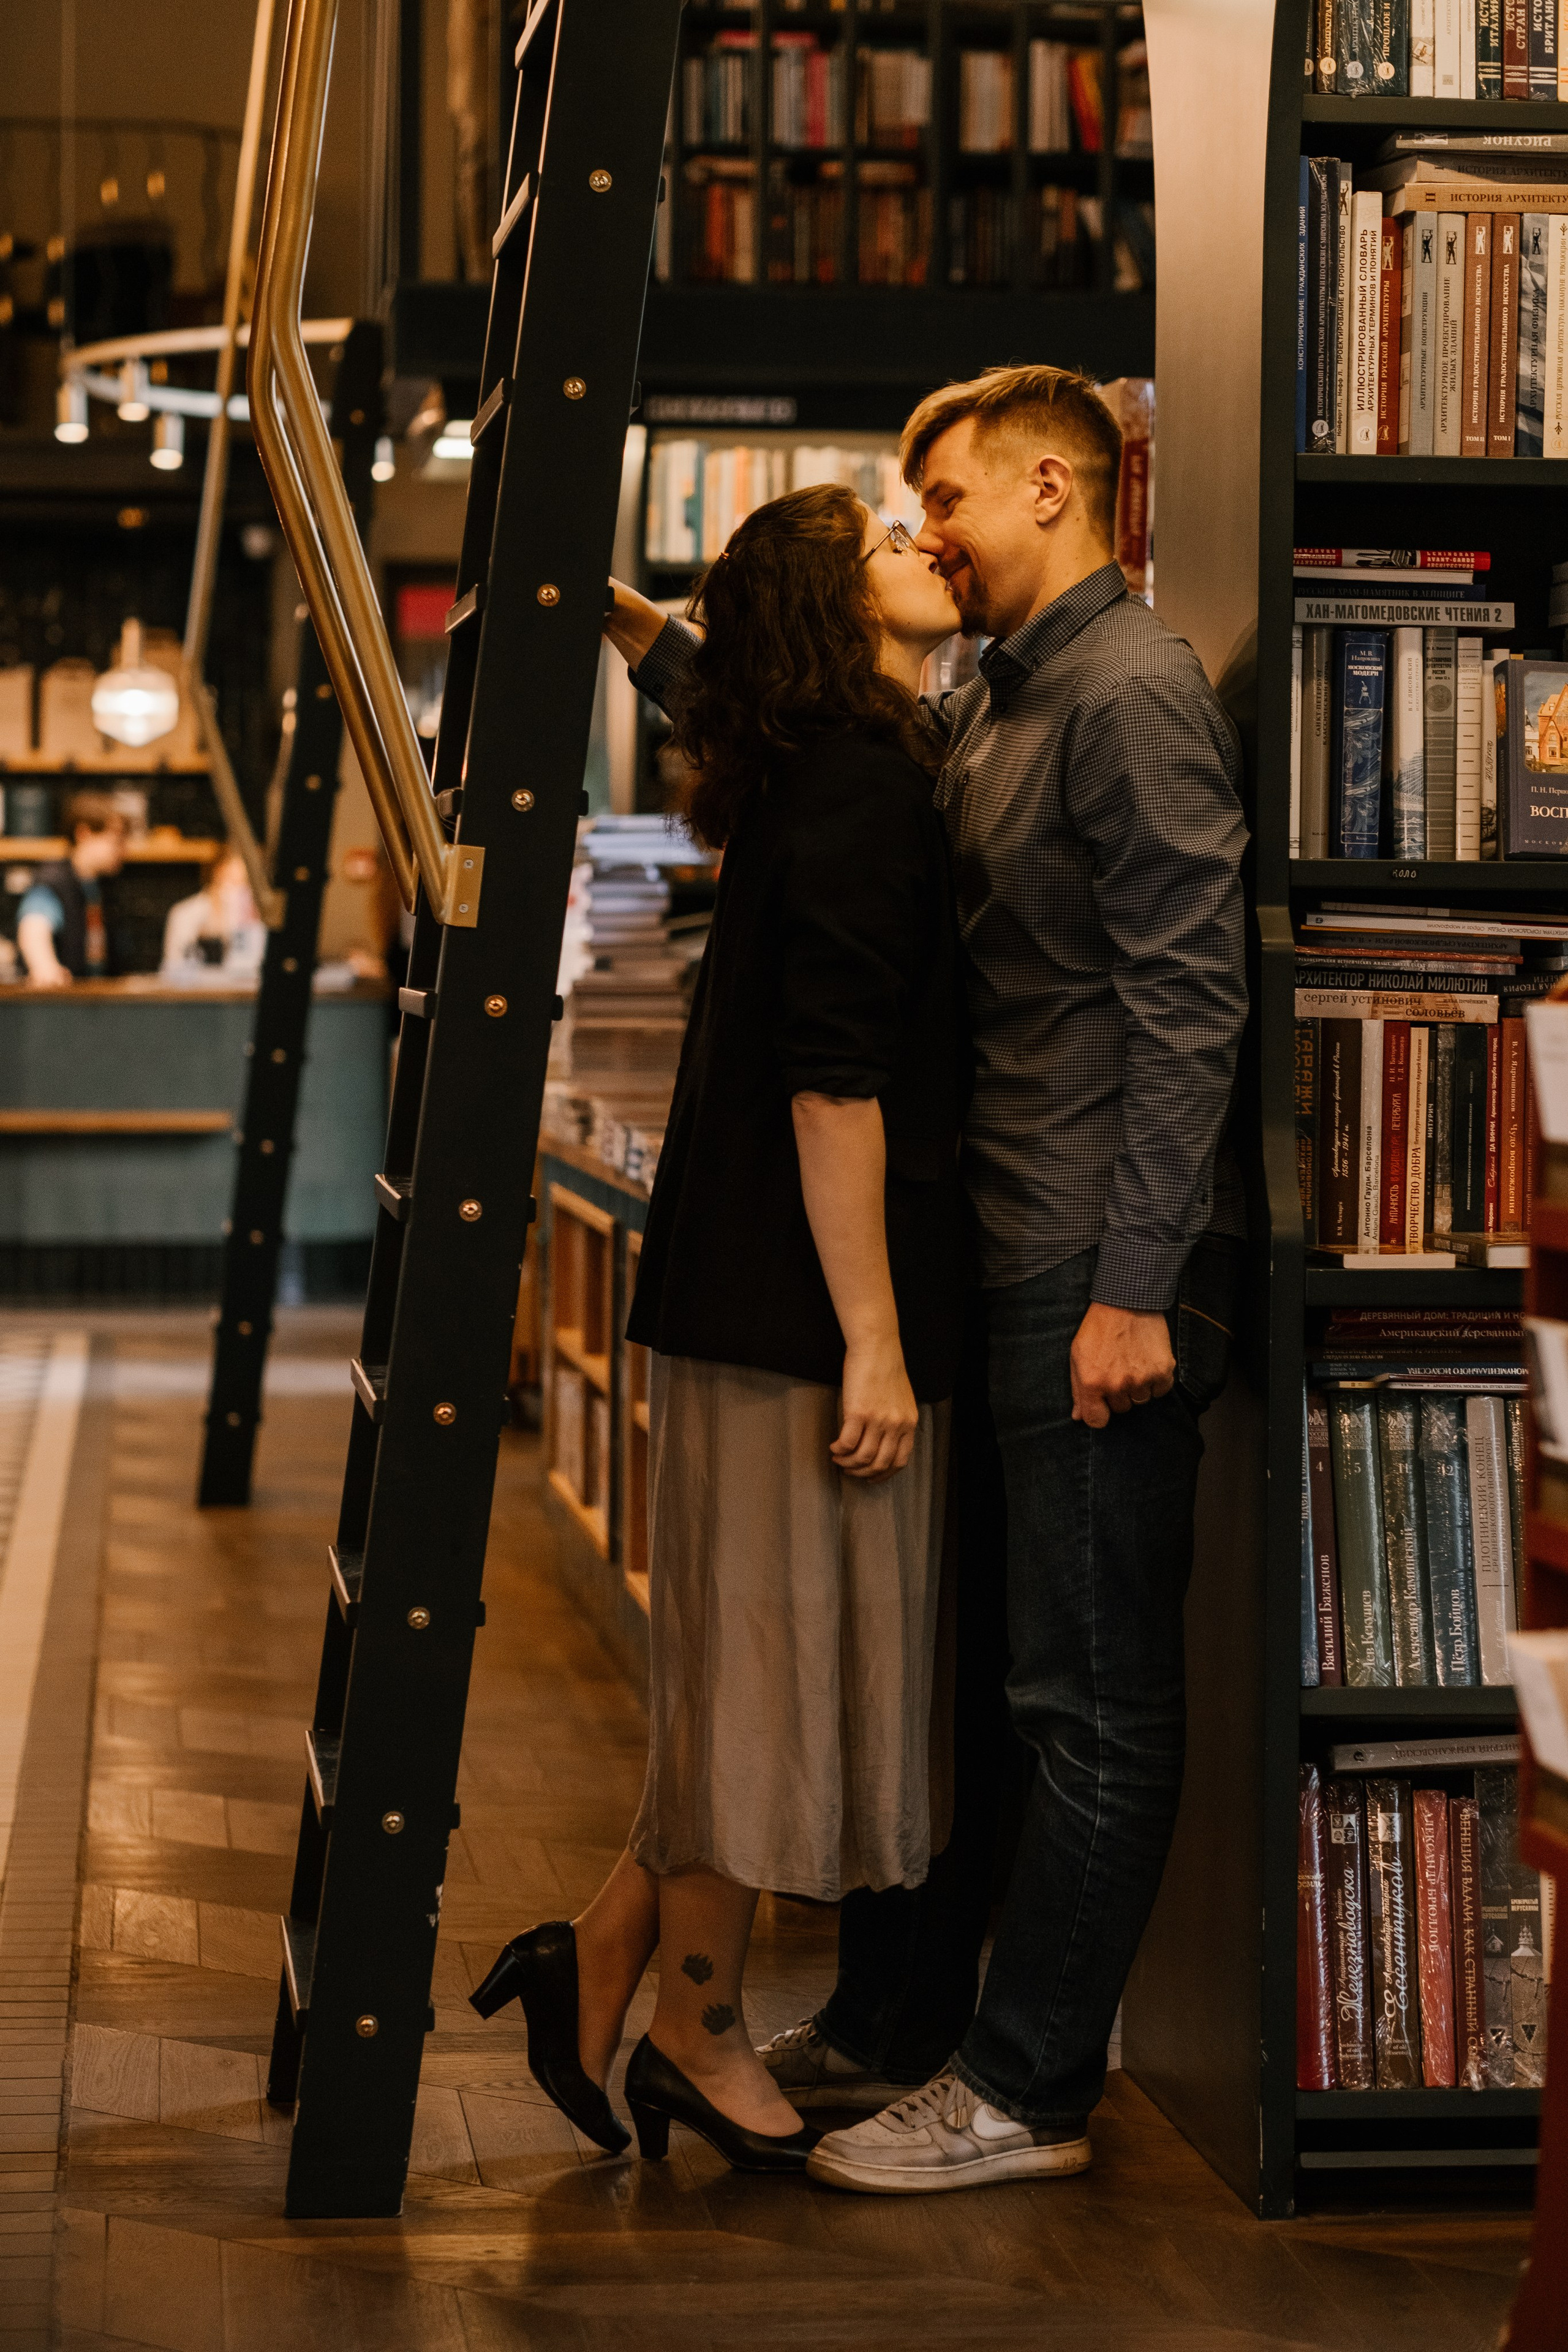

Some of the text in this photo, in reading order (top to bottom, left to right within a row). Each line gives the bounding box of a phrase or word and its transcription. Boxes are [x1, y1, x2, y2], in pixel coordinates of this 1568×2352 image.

[1516, 8, 1526, 50] СТРАН
[1482, 136, 1551, 146] РИСУНОК
[1450, 192, 1502, 203] ИСТОРИЯ
[1357, 228, 1368, 410] ИЛЛЮСТРИРОВАННЫЙ СЛОВАРЬ
[1382, 280, 1390, 338] АРХИТЕКТУРЫ
[1531, 288, 1540, 329] ФИЗИКА
[1440, 276, 1450, 434] АРХИТЕКТУРНОЕ ПРОЕКТИРОВАНИЕ
[1472, 307, 1481, 388] ГРАДОСТРОИТЕЛЬНОГО
[1499, 307, 1509, 387] ГРАДОСТРОИТЕЛЬНОГО
[1367, 335, 1376, 411] АРХИТЕКТУРНЫХ
[1306, 603, 1502, 623] ХАН-МАГОМЕДОВСКИЕ ЧТЕНИЯ 2
[1294, 970, 1488, 992] АРХИТЕКТОР НИКОЛАЙ МИЛЮТИН
[1303, 993, 1422, 1006] сергей устинович
[1503, 984, 1536, 992] ТЕОРИЯ
[1406, 1007, 1465, 1019] соловьёв
[1301, 1029, 1313, 1115] ГАРАЖИ
[1392, 1093, 1401, 1131] ПЕТЕРБУРГА
[1509, 1123, 1518, 1147] Чудо
[1363, 1126, 1372, 1172] Барселона
[1411, 1147, 1422, 1180] ДОБРА
[1489, 1144, 1496, 1153] ДА
[1363, 1201, 1371, 1237] Антонио
[1409, 1181, 1420, 1245] ТВОРЧЕСТВО
[1359, 1311, 1421, 1322] ДЕРЕВЯННЫЙ
[1474, 1436, 1491, 1572] ПЛОТНИЦКИЙ КОНЕЦ
[1484, 1437, 1499, 1573] СРЕДНЕВЕКОВОГО НОВГОРОДА
[1317, 1554, 1335, 1672] Василий Баженов
[1360, 1589, 1377, 1645] Кекушев
[1400, 1528, 1422, 1671] Александр Каминский
[1424, 1811, 1439, 1952] АЛЕКСАНДР БРЮЛЛОВ
[1336, 1866, 1364, 2021] Железноводска
[1463, 1929, 1475, 1957] КАК
[1464, 1958, 1479, 2032] СТРАННЫЙ
